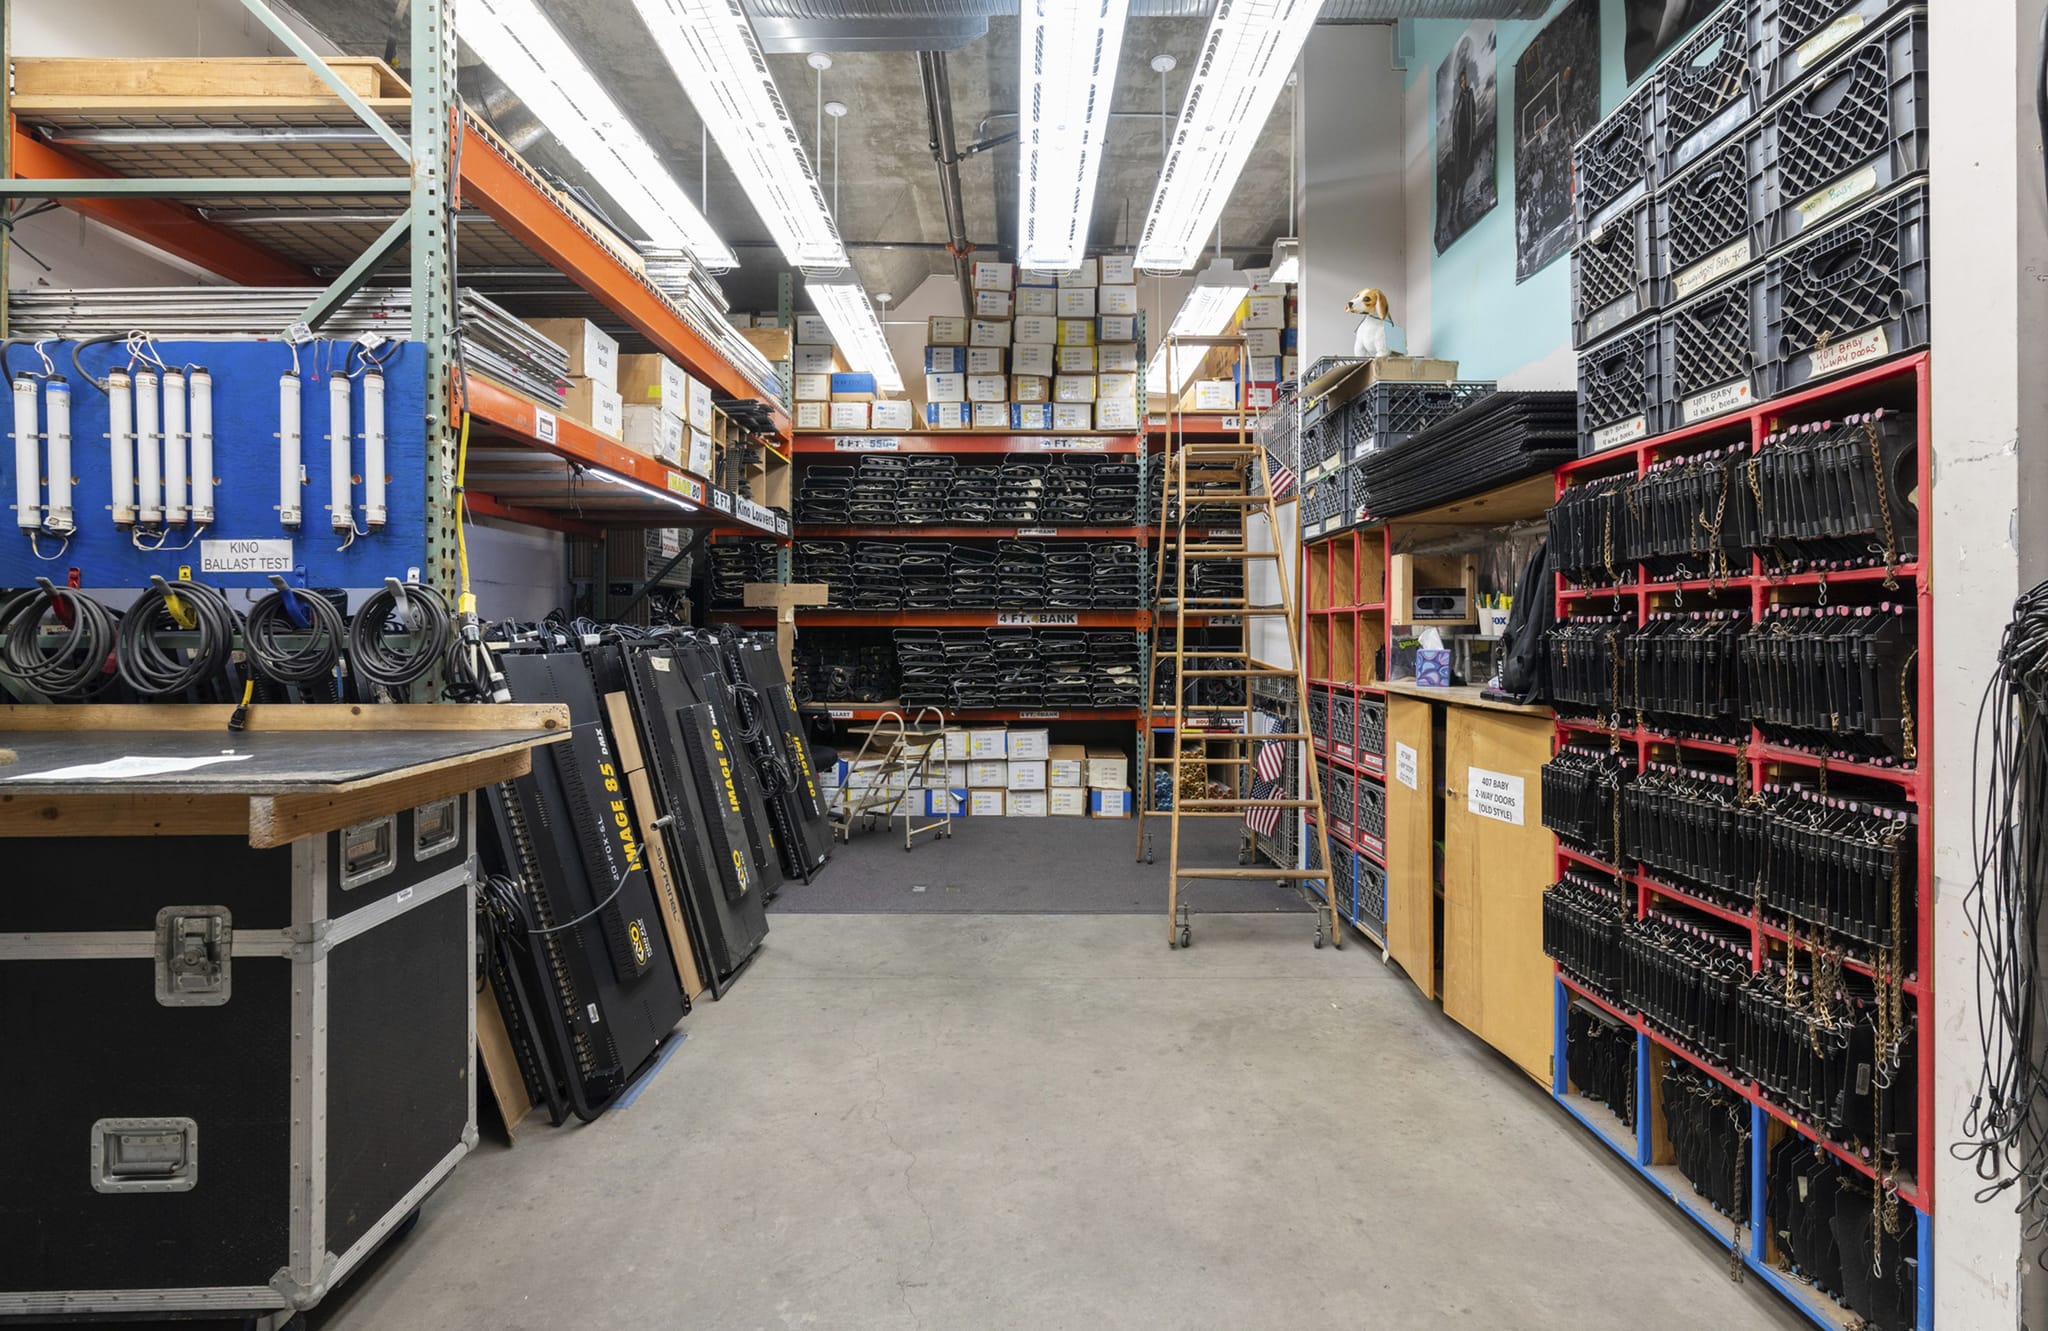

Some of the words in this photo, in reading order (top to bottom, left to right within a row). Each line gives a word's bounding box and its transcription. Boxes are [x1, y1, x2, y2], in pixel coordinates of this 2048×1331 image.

[1816, 347, 1834, 362] 407
[1838, 336, 1863, 354] BABY
[1850, 343, 1877, 361] DOORS
[1710, 386, 1732, 402] BABY
[602, 399, 614, 412] SUPER
[1226, 418, 1232, 427] 4
[837, 439, 844, 447] 4
[1054, 439, 1072, 448] FT.
[692, 484, 700, 500] 80
[714, 492, 720, 507] 2
[720, 494, 730, 510] FT.
[737, 497, 752, 518] Kino
[752, 505, 774, 527] Louvers
[230, 541, 259, 554] KINO
[204, 558, 256, 570] BALLAST
[261, 557, 289, 570] TEST
[999, 613, 1007, 623] 4
[1011, 613, 1031, 624] FT.
[1210, 616, 1219, 625] 2
[595, 727, 609, 755] DMX
[711, 728, 724, 752] 80
[792, 736, 811, 777] IMAGE
[806, 780, 817, 798] 80
[719, 756, 741, 813] IMAGE
[1481, 776, 1492, 786] 407
[1492, 779, 1510, 791] BABY
[1475, 788, 1494, 801] 2-WAY
[1494, 794, 1516, 807] DOORS
[1478, 802, 1493, 815] (OLD
[1493, 807, 1513, 822] STYLE)
[610, 799, 643, 872] IMAGE
